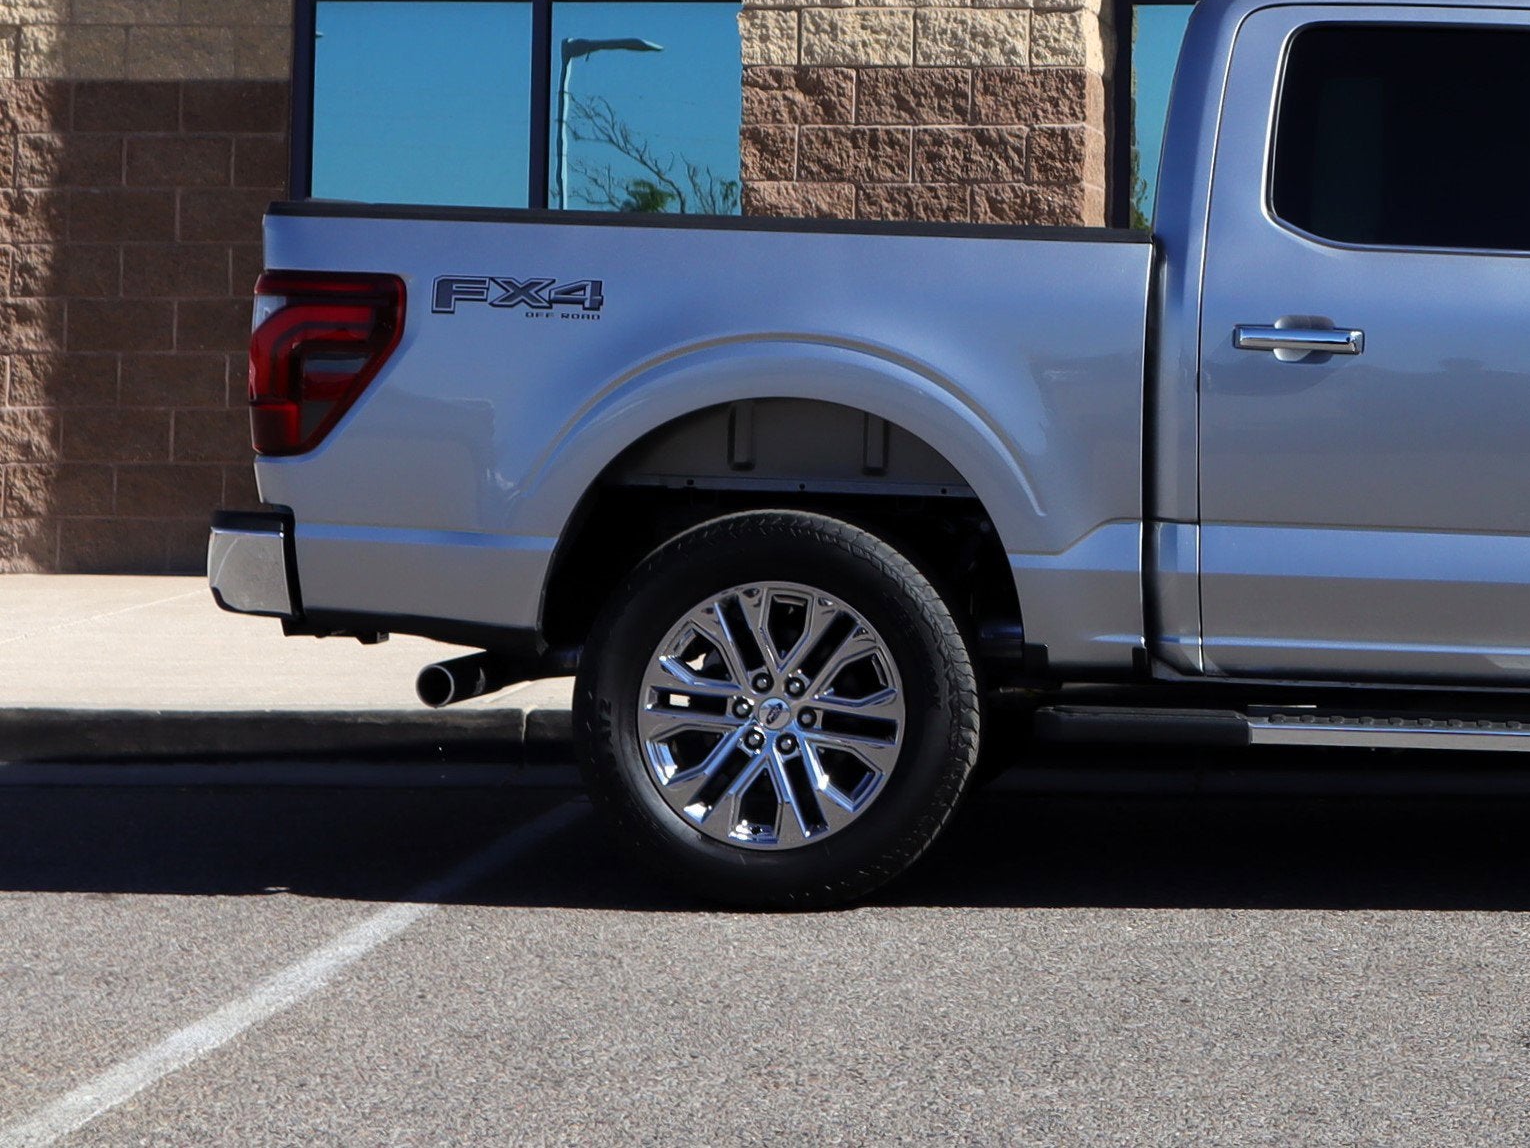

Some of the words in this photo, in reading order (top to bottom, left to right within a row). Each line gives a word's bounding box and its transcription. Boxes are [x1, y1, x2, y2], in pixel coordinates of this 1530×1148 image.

[431, 274, 604, 314] FX4
[525, 311, 555, 319] OFF
[561, 312, 601, 320] ROAD
